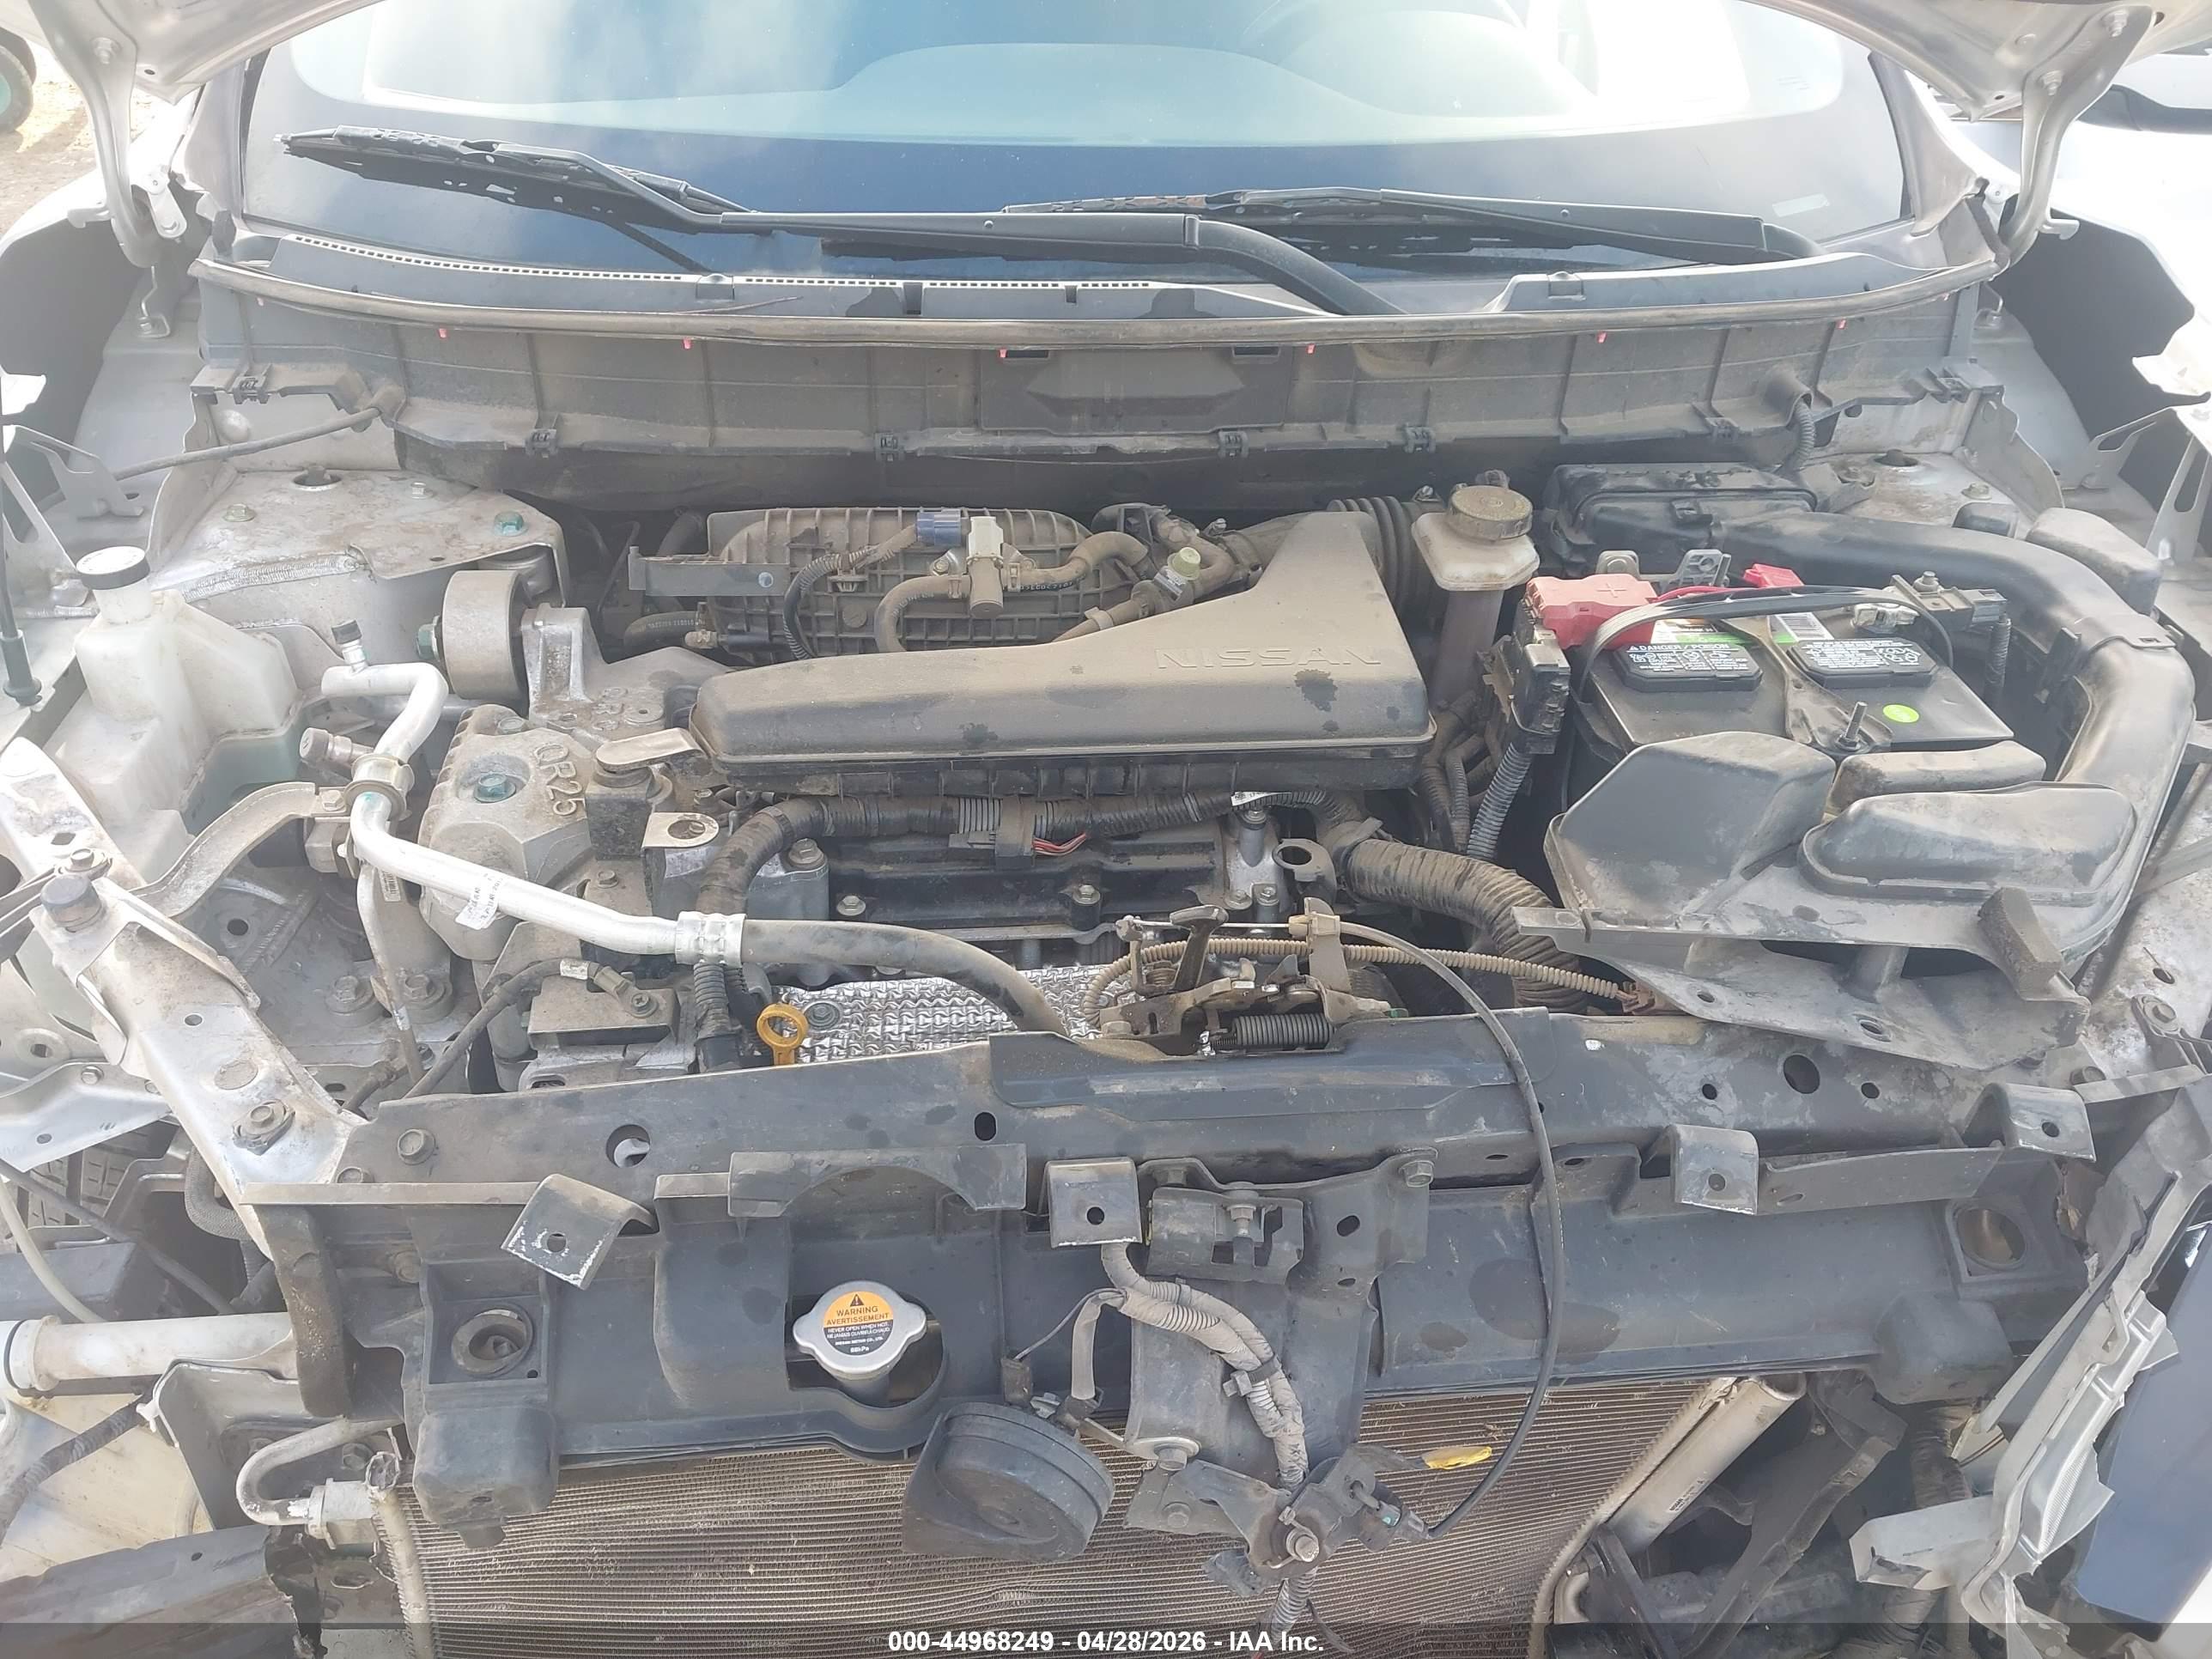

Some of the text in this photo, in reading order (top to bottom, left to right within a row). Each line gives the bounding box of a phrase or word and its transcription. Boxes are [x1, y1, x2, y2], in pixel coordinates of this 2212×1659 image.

[1155, 647, 1382, 669] NISSAN
[534, 742, 586, 816] QR25
[826, 1312, 890, 1325] AVERTISSEMENT
[836, 1306, 878, 1316] WARNING
